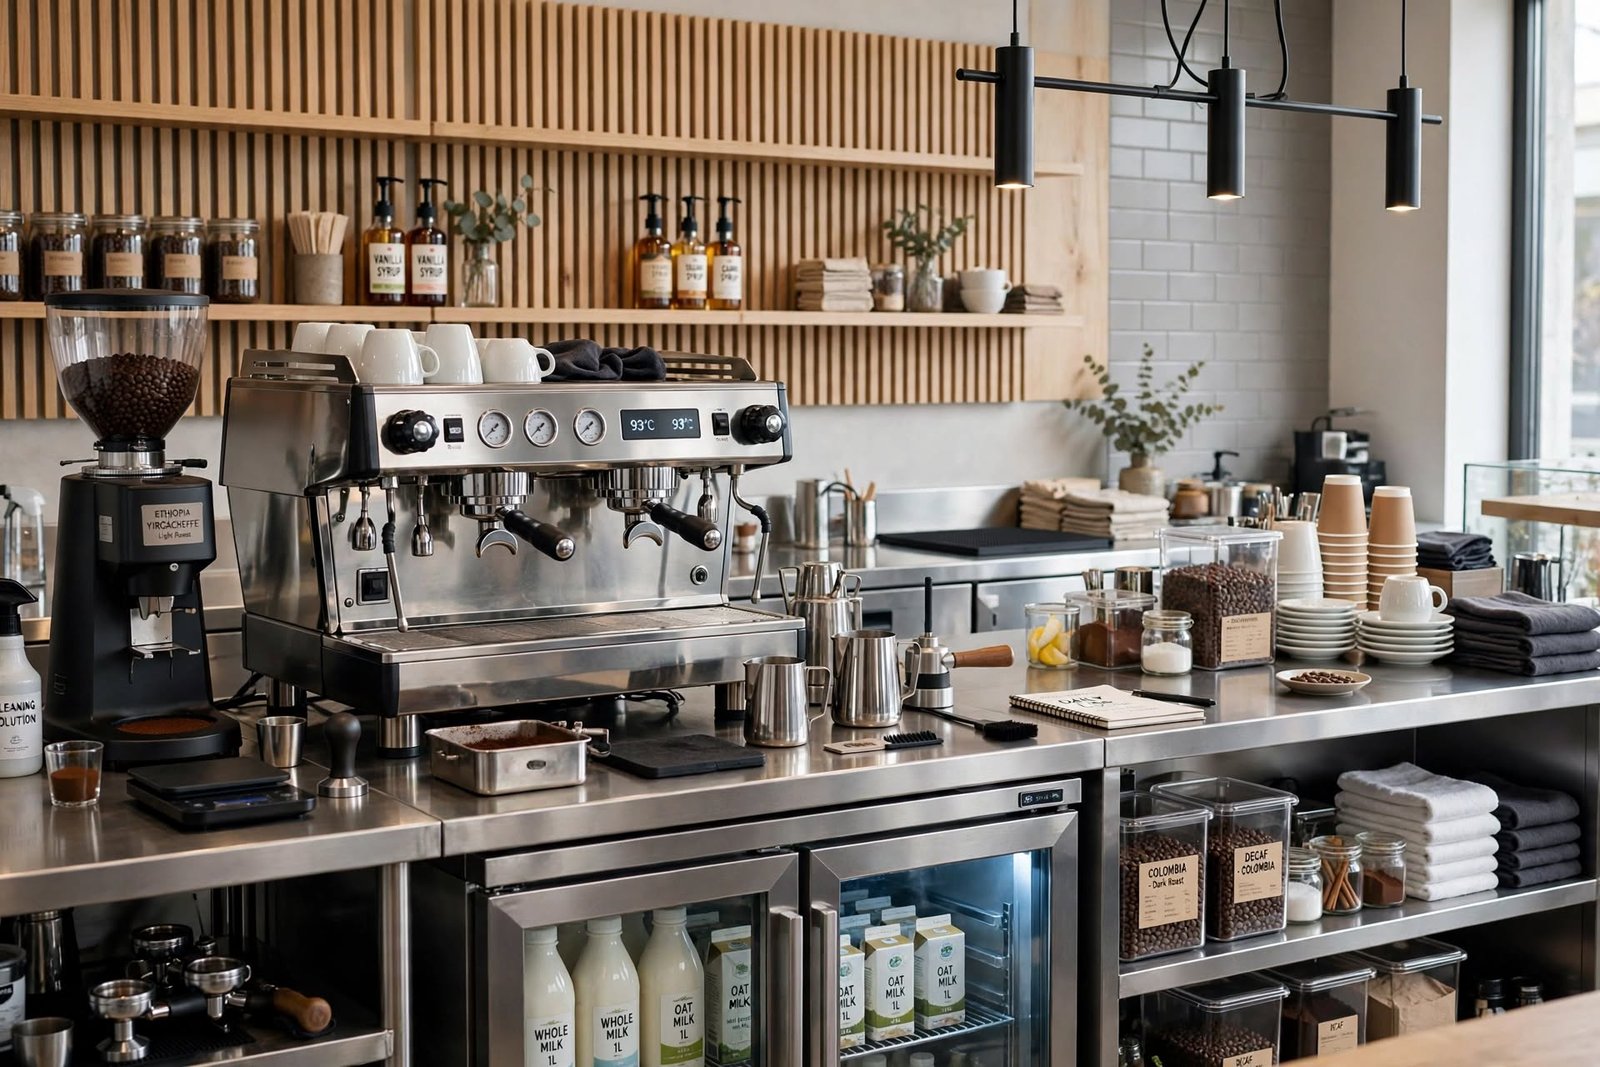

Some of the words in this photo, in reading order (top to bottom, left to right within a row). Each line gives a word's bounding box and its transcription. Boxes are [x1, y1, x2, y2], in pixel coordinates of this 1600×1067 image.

[0, 700, 36, 713] LEANING
[0, 714, 36, 727] OLUTION
[1245, 849, 1268, 862] DECAF
[1148, 863, 1187, 878] COLOMBIA
[1241, 861, 1275, 876] COLOMBIA
[1152, 878, 1166, 889] Dark
[937, 965, 953, 976] OAT
[888, 975, 904, 986] OAT
[938, 975, 957, 987] MILK
[731, 984, 749, 996] OAT
[885, 986, 905, 999] MILK
[944, 990, 952, 999] 1L
[674, 1002, 693, 1015] OAT
[729, 996, 751, 1009] MILK
[892, 1000, 900, 1010] 1L
[600, 1013, 633, 1029] WHOLE
[673, 1013, 695, 1028] MILK
[842, 1011, 850, 1020] 1L
[534, 1024, 568, 1041] WHOLE
[606, 1026, 629, 1040] MILK
[680, 1029, 689, 1040] 1L
[540, 1039, 563, 1053] MILK
[614, 1042, 622, 1053] 1L
[548, 1055, 557, 1066] 1L
